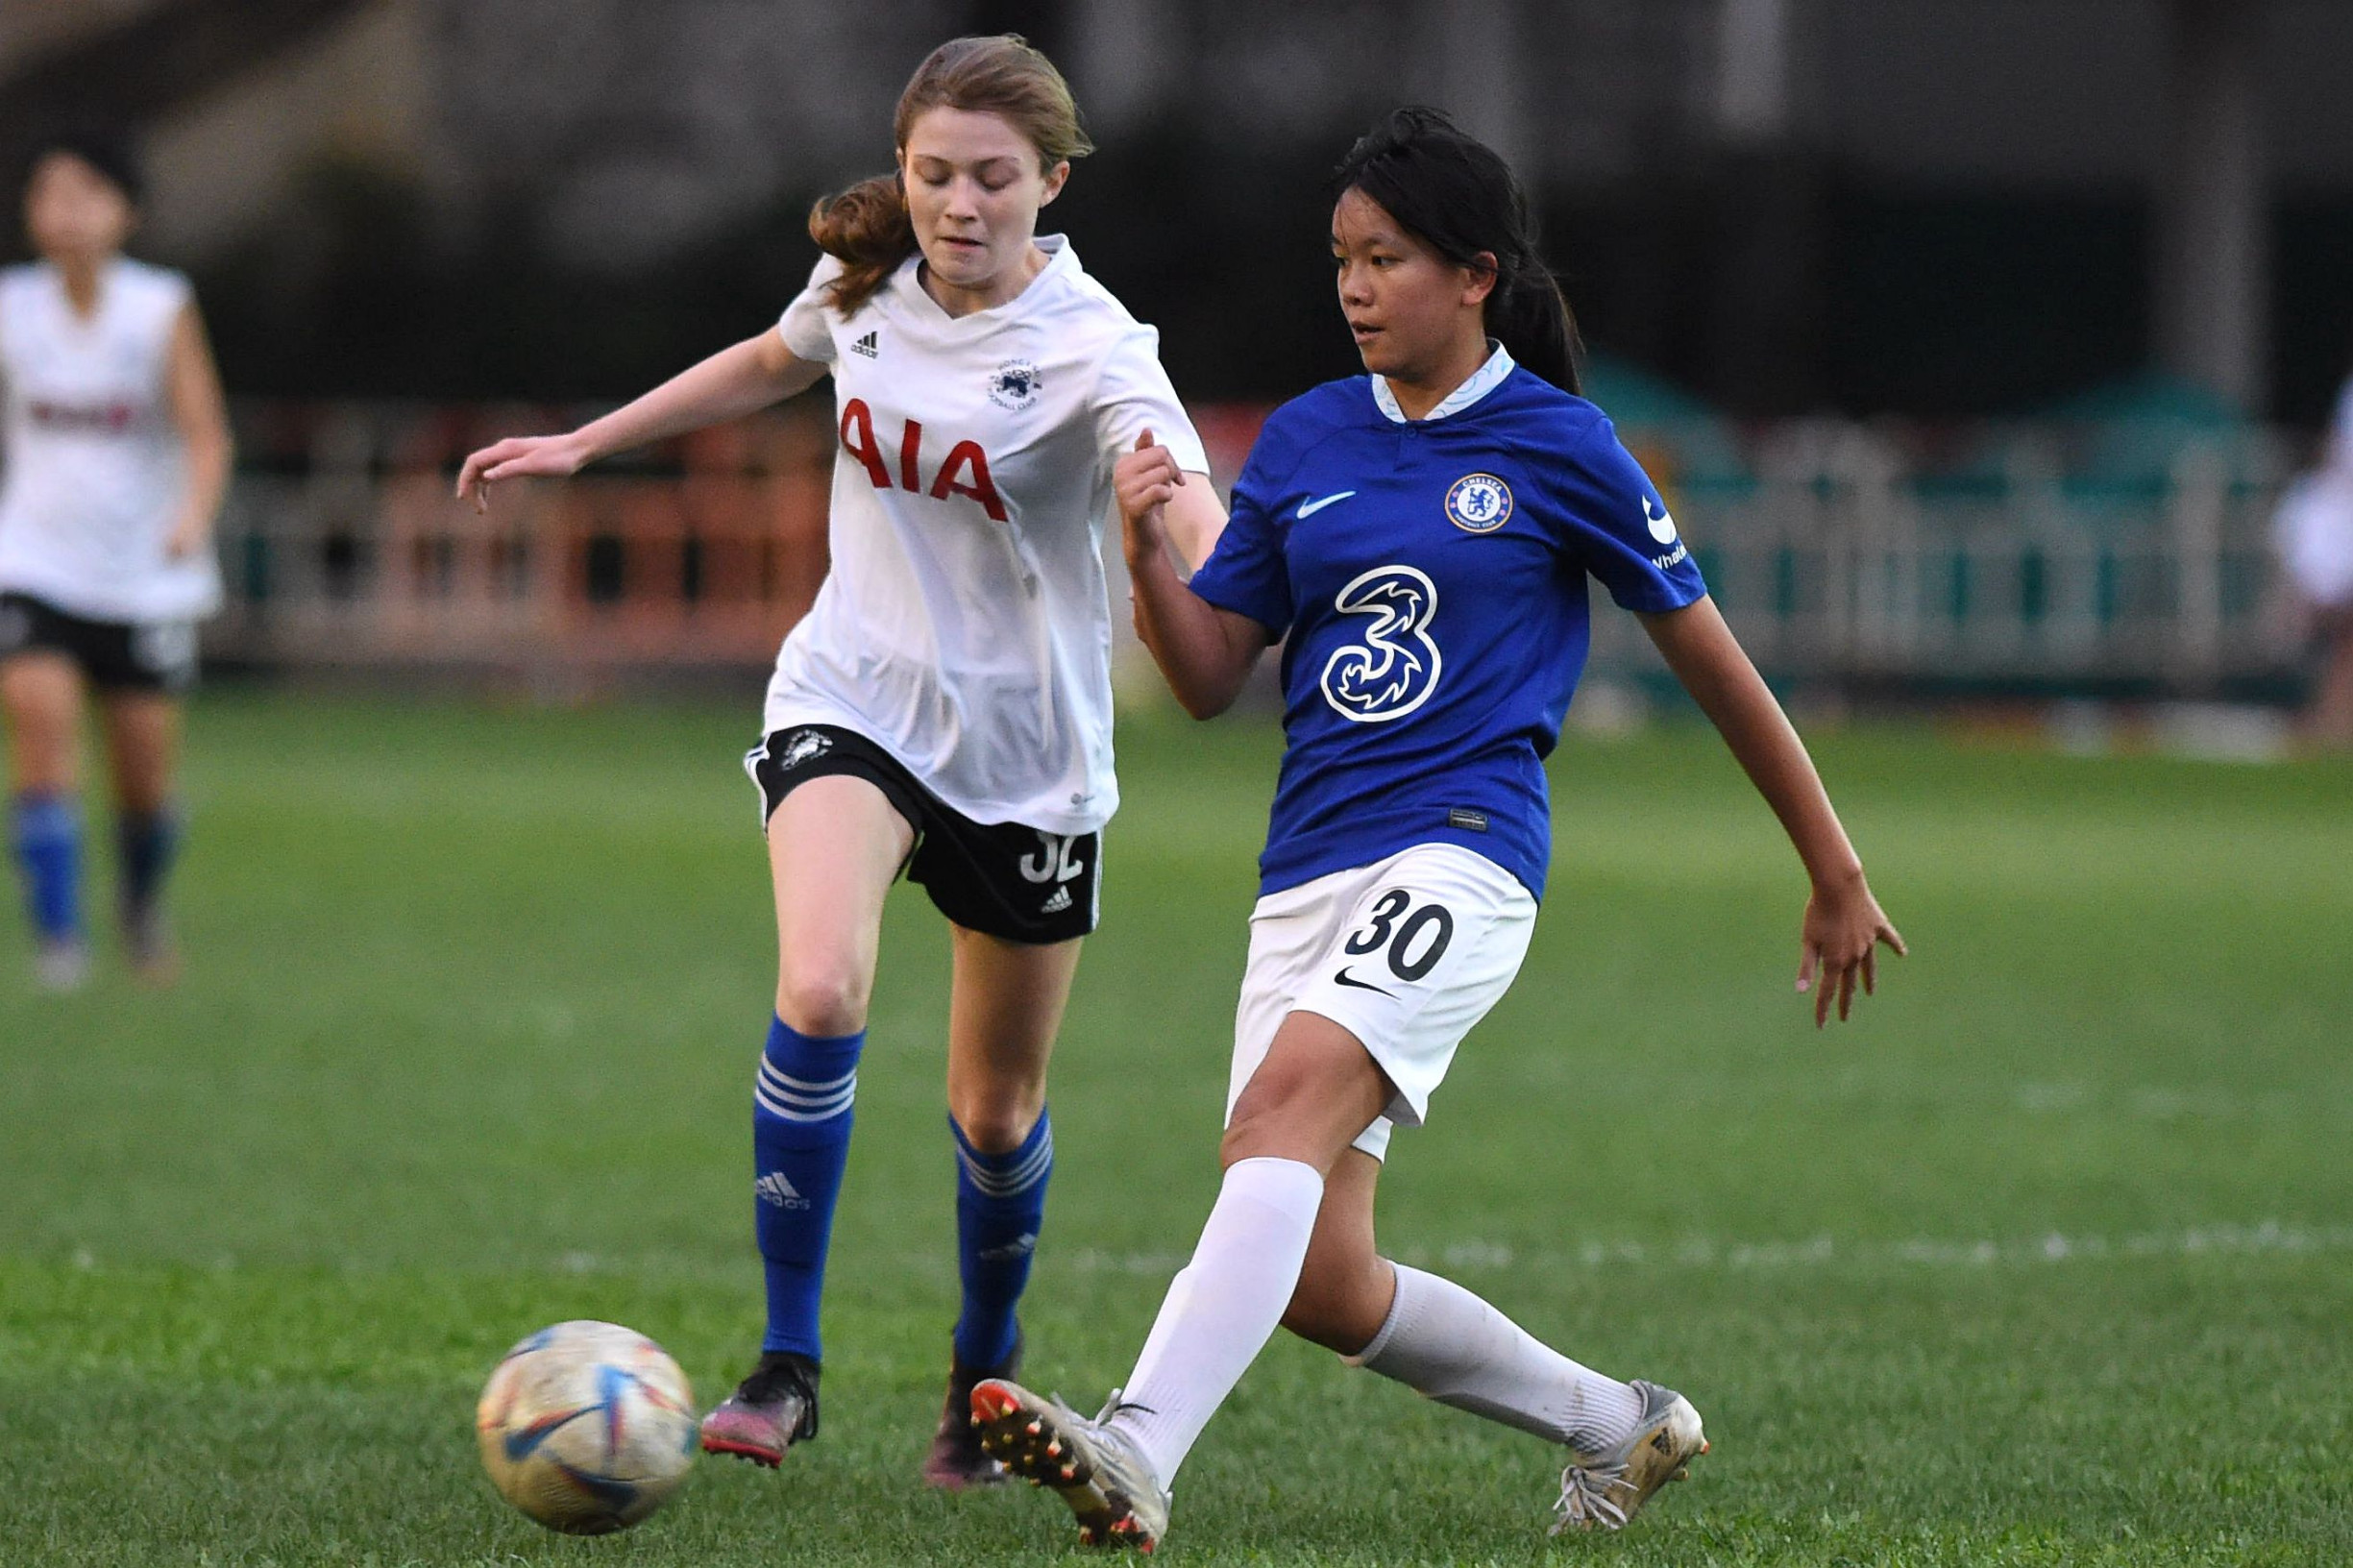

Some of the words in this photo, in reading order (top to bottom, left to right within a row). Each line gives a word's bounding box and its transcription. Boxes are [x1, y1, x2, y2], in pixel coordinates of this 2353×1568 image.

[840, 397, 1009, 523] AIA
[1461, 478, 1503, 493] CHELSEA
[1344, 889, 1454, 982] 30
